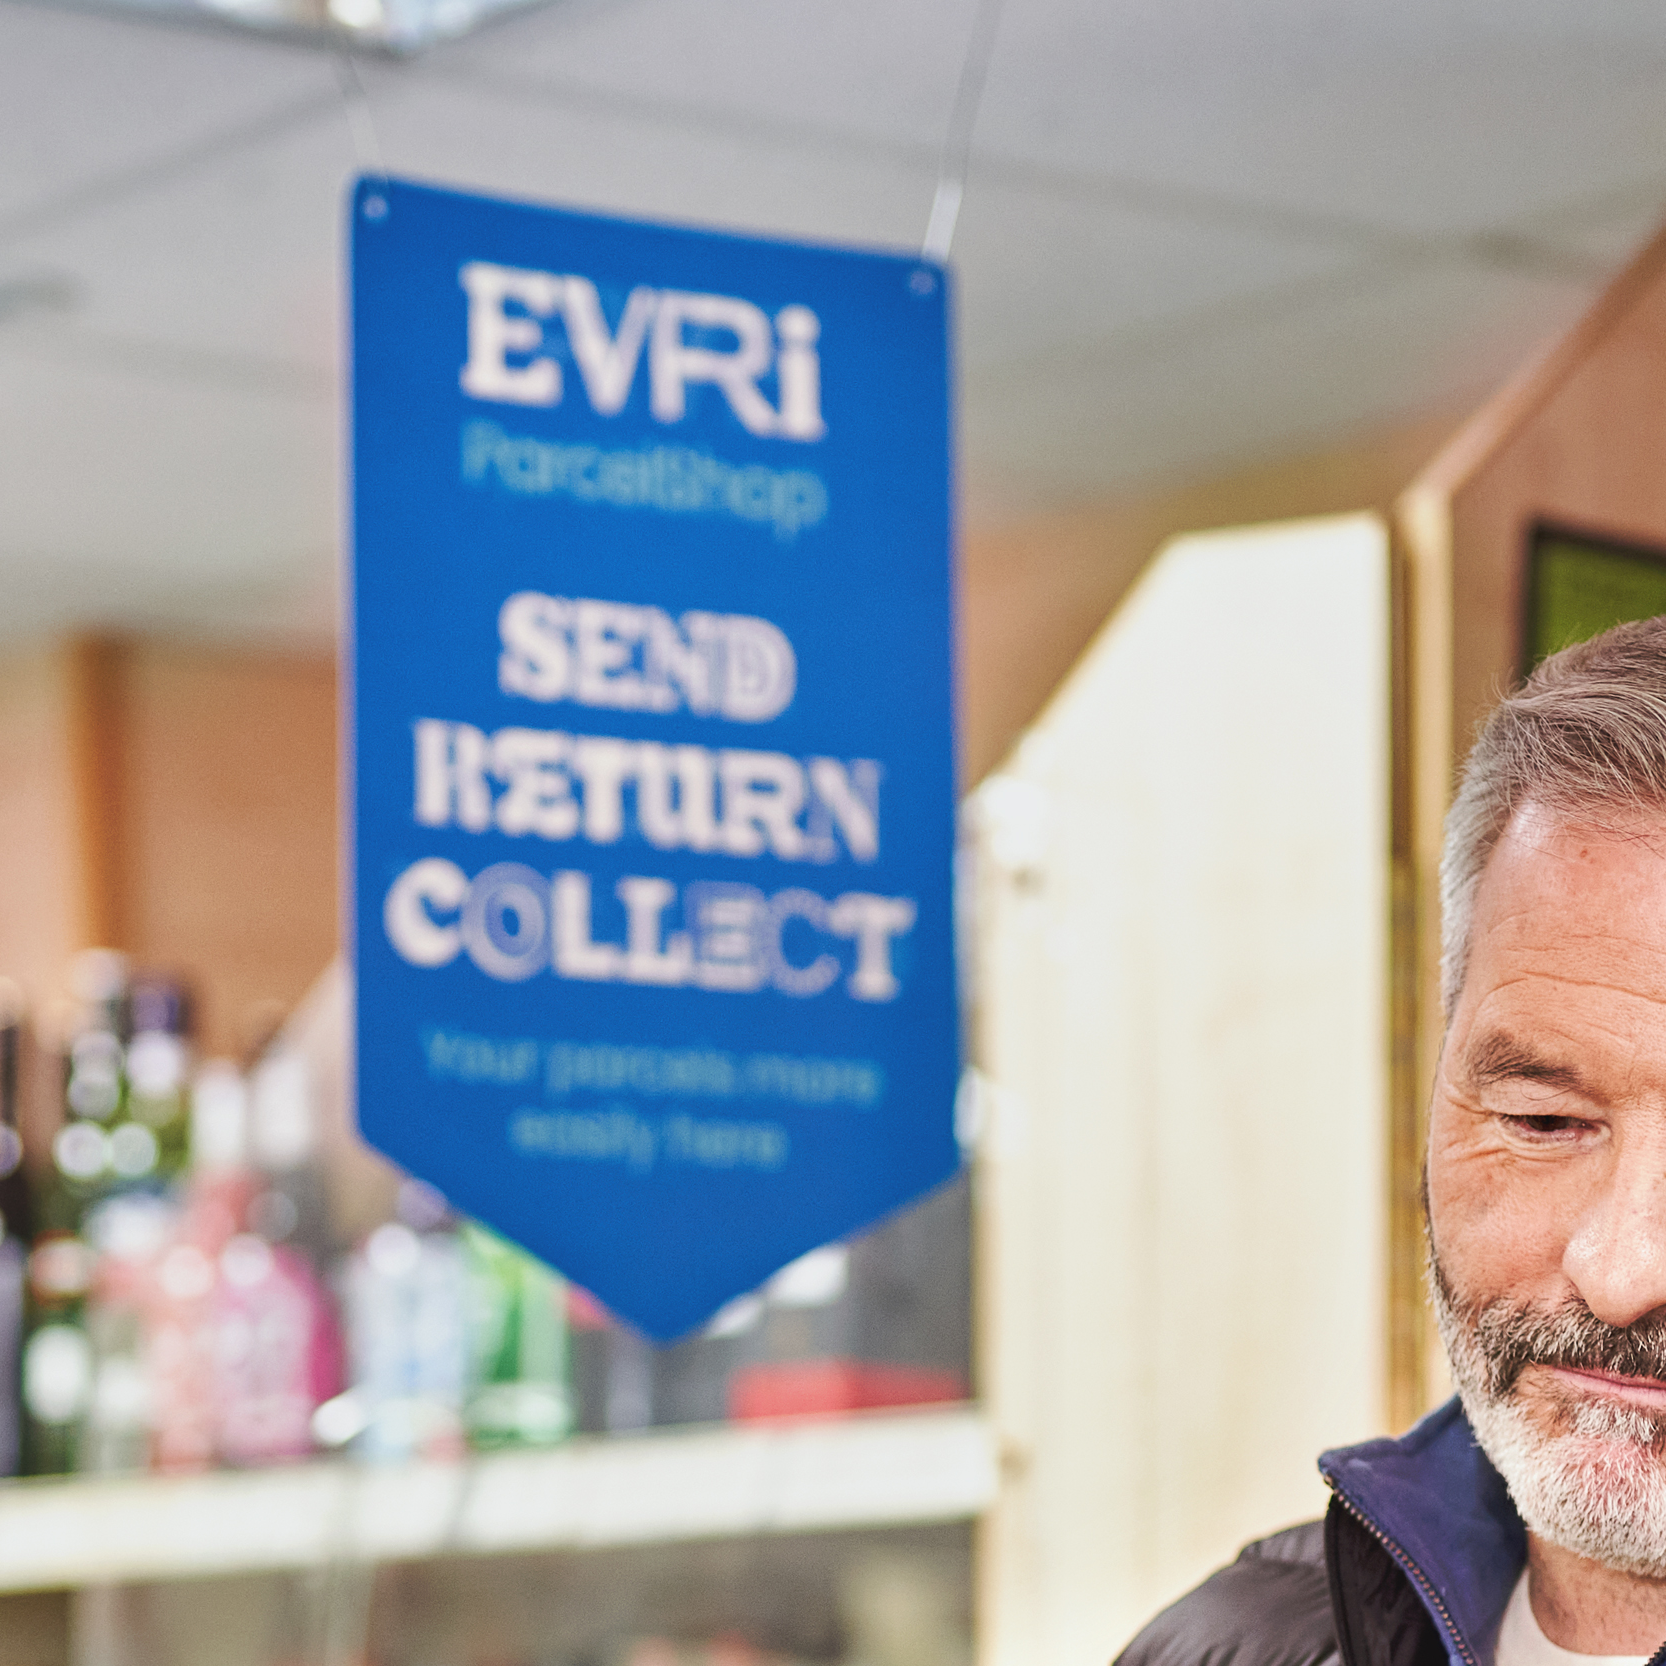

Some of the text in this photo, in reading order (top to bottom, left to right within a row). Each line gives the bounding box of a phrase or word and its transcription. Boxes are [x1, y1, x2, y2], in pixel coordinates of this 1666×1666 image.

[499, 590, 798, 724] SEND
[413, 717, 881, 865] RETURN
[383, 857, 917, 1000] COLLECT
